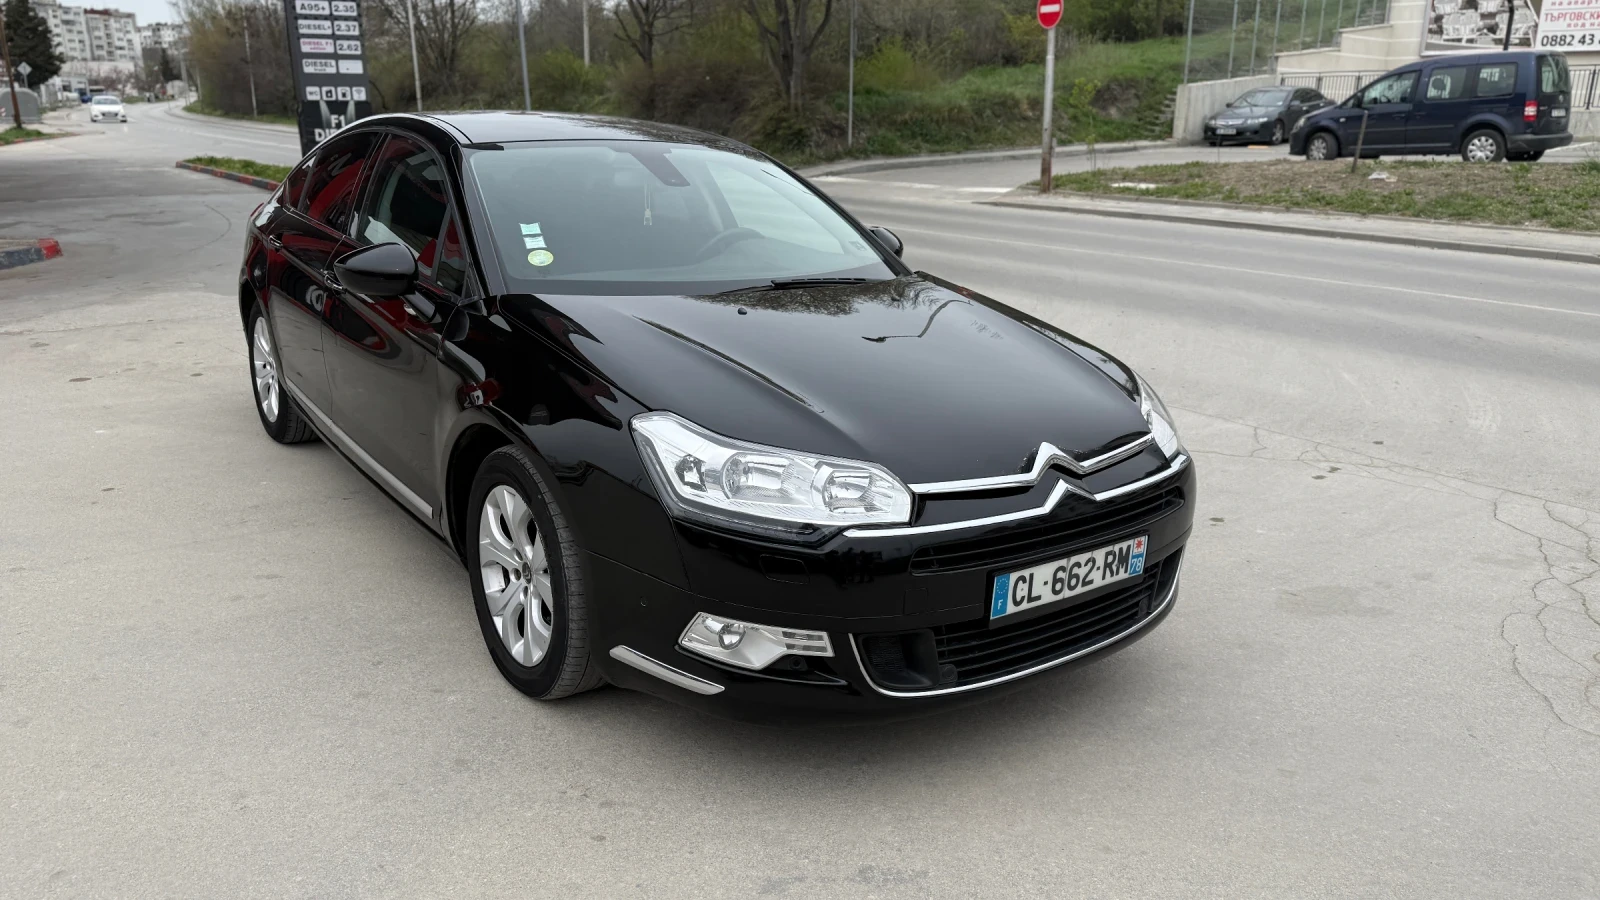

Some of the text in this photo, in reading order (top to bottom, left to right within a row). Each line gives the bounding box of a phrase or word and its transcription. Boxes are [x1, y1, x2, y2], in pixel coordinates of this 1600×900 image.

[300, 3, 326, 11] A95+
[333, 4, 355, 13] 2.35
[335, 24, 357, 32] 2.37
[1541, 34, 1575, 47] 0882
[1578, 33, 1595, 46] 43
[338, 43, 359, 52] 2.62
[304, 60, 334, 68] DIESEL
[331, 114, 346, 128] F1
[1130, 556, 1143, 573] 78
[1012, 544, 1132, 607] CL-662-RM
[997, 599, 1004, 610] F
